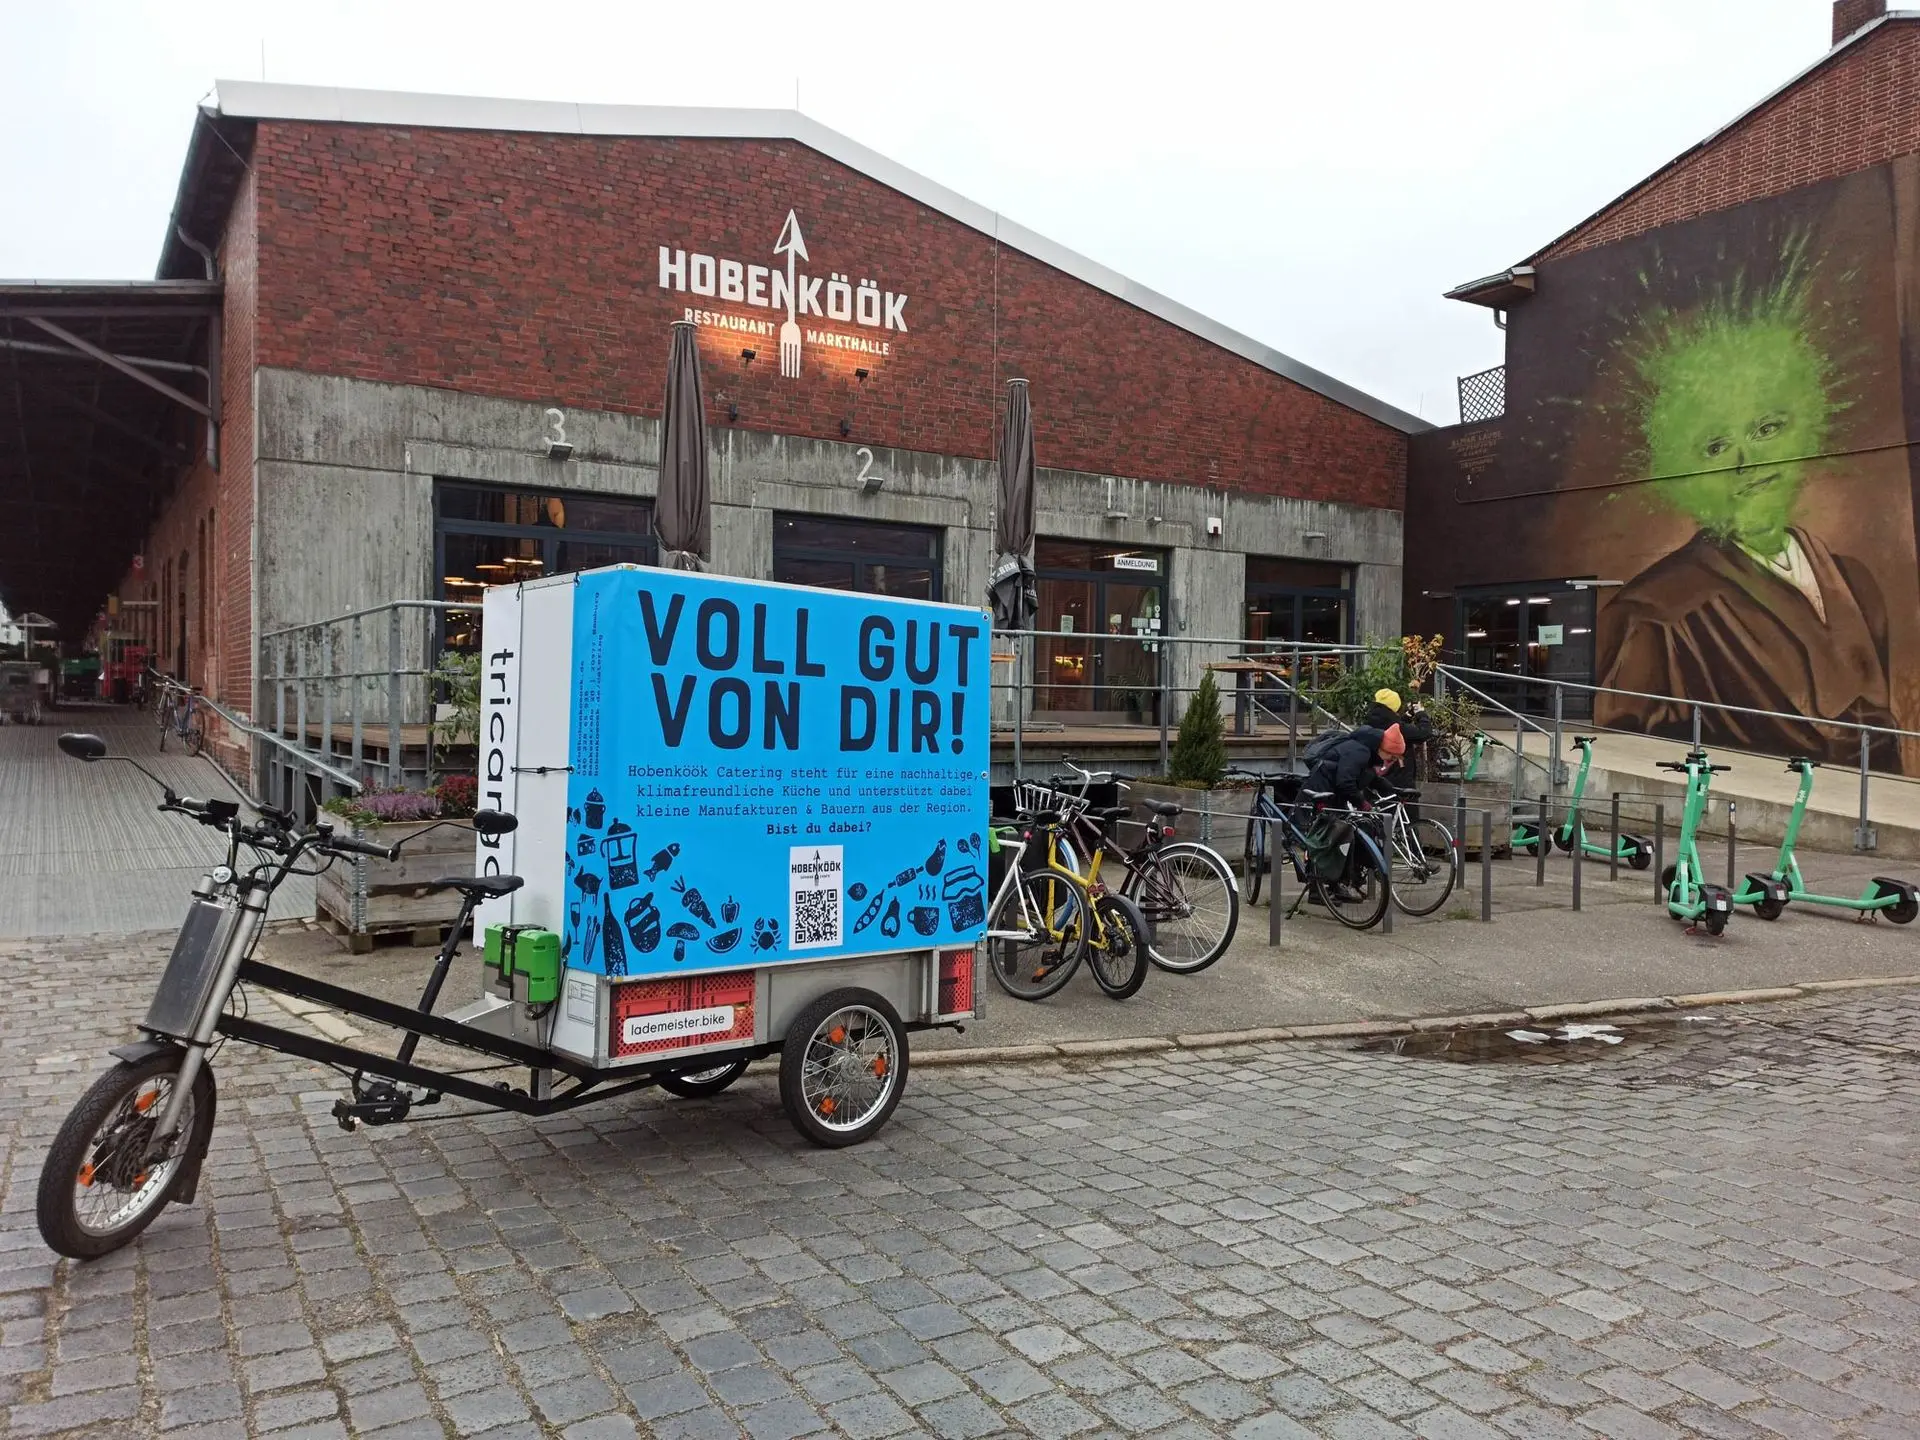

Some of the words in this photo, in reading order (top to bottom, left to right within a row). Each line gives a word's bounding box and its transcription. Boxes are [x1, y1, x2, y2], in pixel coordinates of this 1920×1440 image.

[659, 245, 908, 333] HOBENKÖÖK
[684, 307, 775, 336] RESTAURANT
[807, 329, 890, 355] MARKTHALLE
[543, 407, 565, 444] 3
[856, 447, 874, 482] 2
[1117, 559, 1155, 569] ANMELDUNG
[638, 590, 826, 678] VOLL
[859, 615, 979, 687] GUT
[651, 672, 801, 750] VON
[840, 684, 966, 755] DIR!
[629, 764, 709, 778] Hobenköök
[717, 766, 782, 781] Catering
[790, 767, 828, 779] steht
[836, 767, 858, 779] für
[865, 768, 894, 780] eine
[901, 768, 978, 783] nachhaltige,
[637, 784, 774, 797] klimafreundliche
[782, 784, 821, 797] Küche
[828, 785, 850, 797] und
[858, 785, 934, 797] unterstützt
[940, 785, 973, 796] dabei
[636, 804, 690, 817] kleine
[698, 803, 798, 816] Manufakturen
[805, 804, 813, 815] &
[821, 804, 866, 814] Bauern
[872, 804, 893, 814] aus
[899, 802, 920, 813] der
[926, 802, 972, 815] Region.
[766, 823, 798, 835] Bist
[806, 822, 822, 834] du
[828, 821, 873, 833] dabei?
[791, 861, 841, 874] HOBENKÖÖK
[631, 1013, 725, 1036] lademeister.bike
